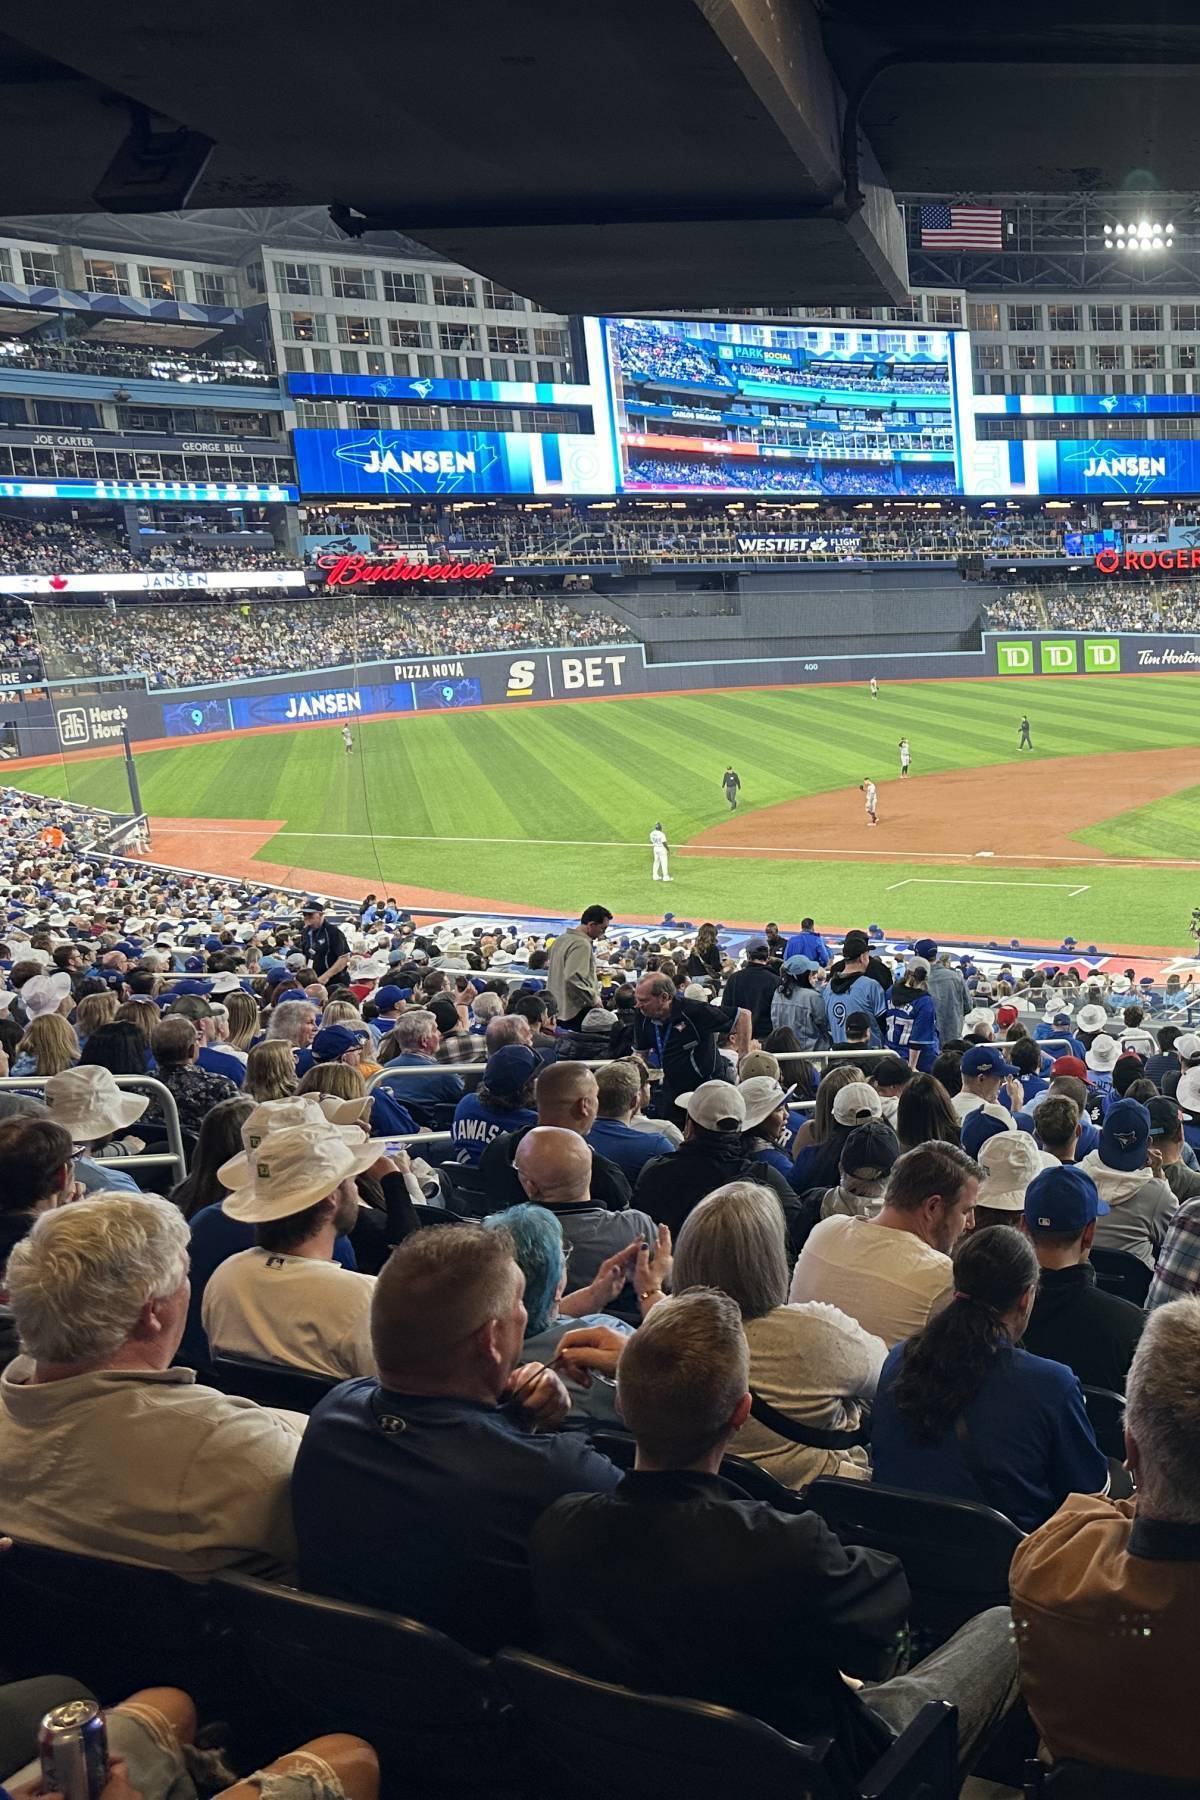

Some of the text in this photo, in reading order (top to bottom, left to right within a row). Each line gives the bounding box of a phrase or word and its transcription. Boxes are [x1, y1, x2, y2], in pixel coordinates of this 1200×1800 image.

[735, 347, 763, 359] PARK
[34, 435, 94, 447] JOE CARTER
[182, 441, 245, 453] GEORGE BELL
[363, 449, 477, 475] JANSEN
[1083, 457, 1166, 477] JANSEN
[830, 537, 861, 547] FLIGHT
[142, 572, 209, 588] JANSEN
[317, 554, 495, 587] Budweiser
[1001, 647, 1029, 668] TD
[1045, 646, 1073, 667] TD
[1088, 645, 1116, 665] TD
[1138, 650, 1161, 665] Tim
[394, 662, 464, 681] PIZZA NOVA
[506, 656, 626, 690] S BET
[804, 663, 818, 672] 400
[89, 705, 128, 723] Here's
[191, 687, 453, 726] 9 JANSEN 9
[92, 723, 124, 739] How.
[833, 1003, 846, 1027] 9
[885, 1015, 915, 1046] 17
